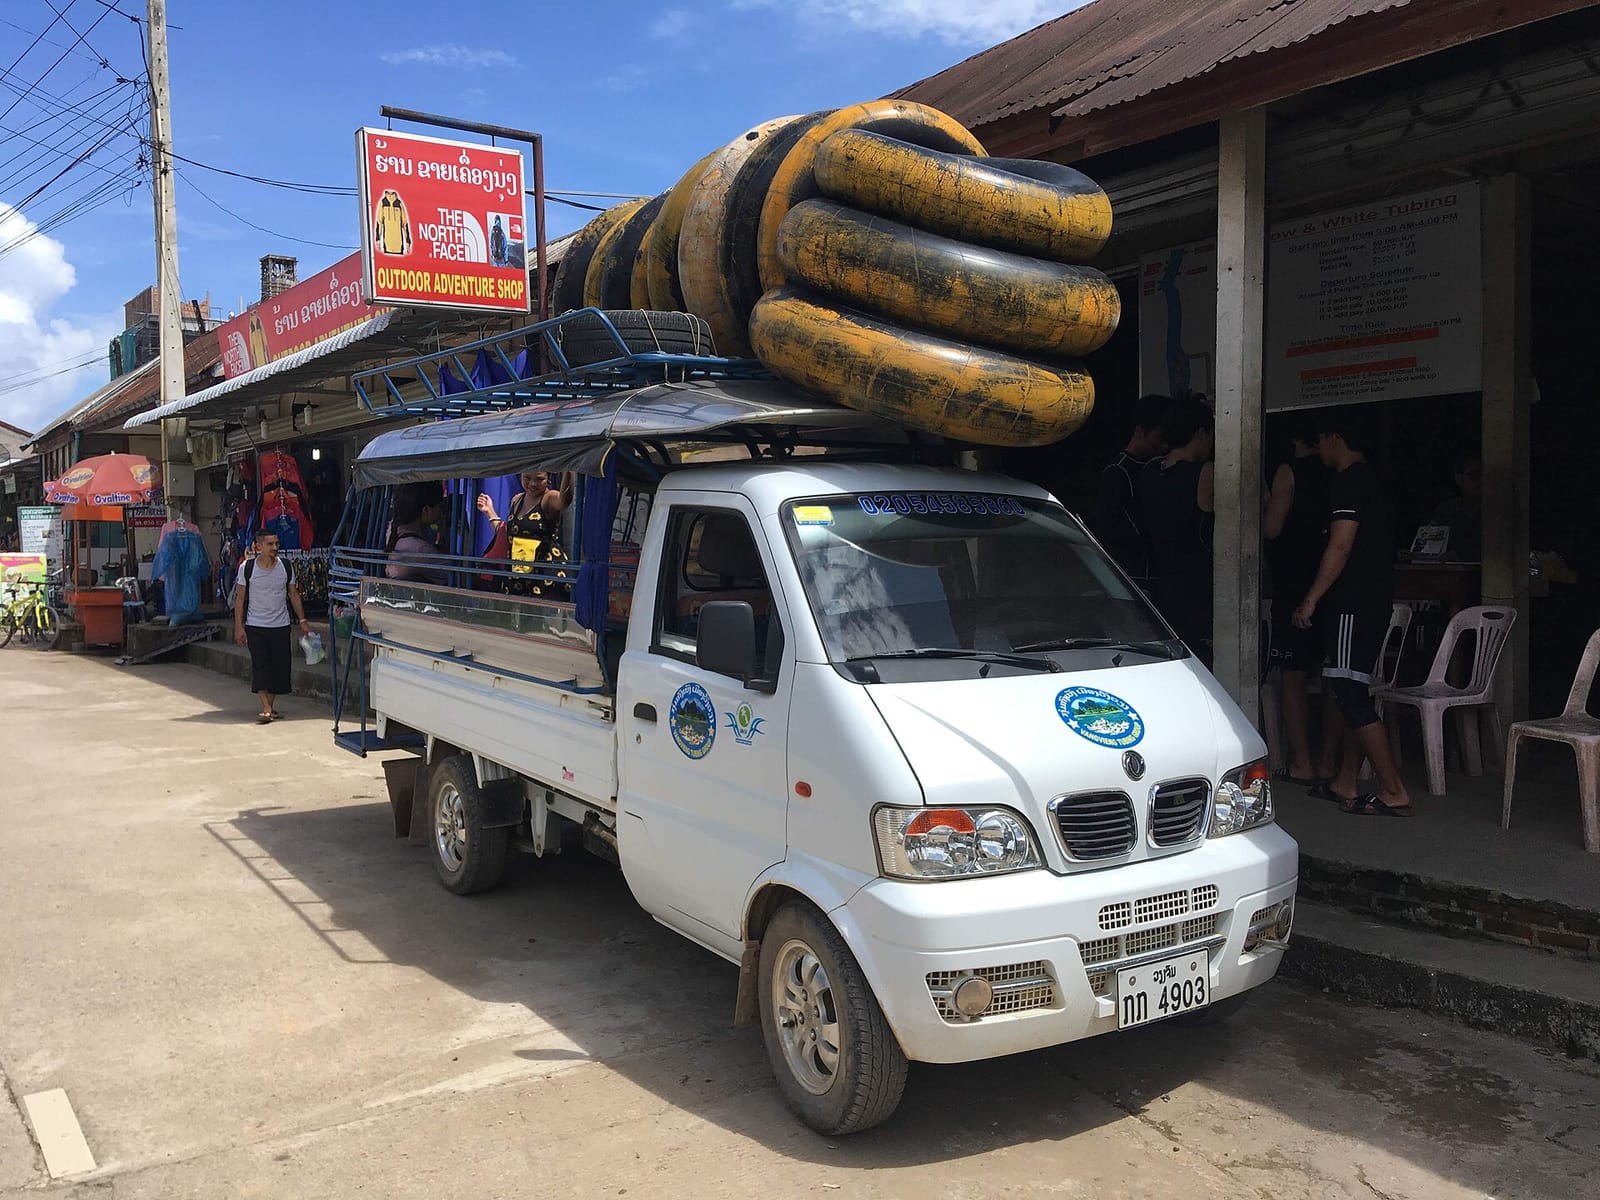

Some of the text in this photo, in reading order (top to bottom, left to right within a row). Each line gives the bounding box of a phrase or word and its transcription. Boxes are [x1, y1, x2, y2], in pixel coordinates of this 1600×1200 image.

[437, 208, 463, 227] THE
[1321, 207, 1378, 230] White
[1386, 191, 1457, 217] Tubing
[418, 223, 464, 243] NORTH
[1351, 229, 1373, 240] from
[1441, 211, 1458, 223] PM
[432, 242, 465, 261] FACE
[377, 267, 524, 301] OUTDOOR ADVENTURE SHOP
[1320, 265, 1414, 288] Departure Schedule
[63, 473, 94, 485] Ovaltine
[54, 493, 80, 504] Ovaltine
[95, 493, 133, 505] Ovaltine
[858, 495, 1026, 516] 02054585860
[1158, 975, 1205, 1014] 4903
